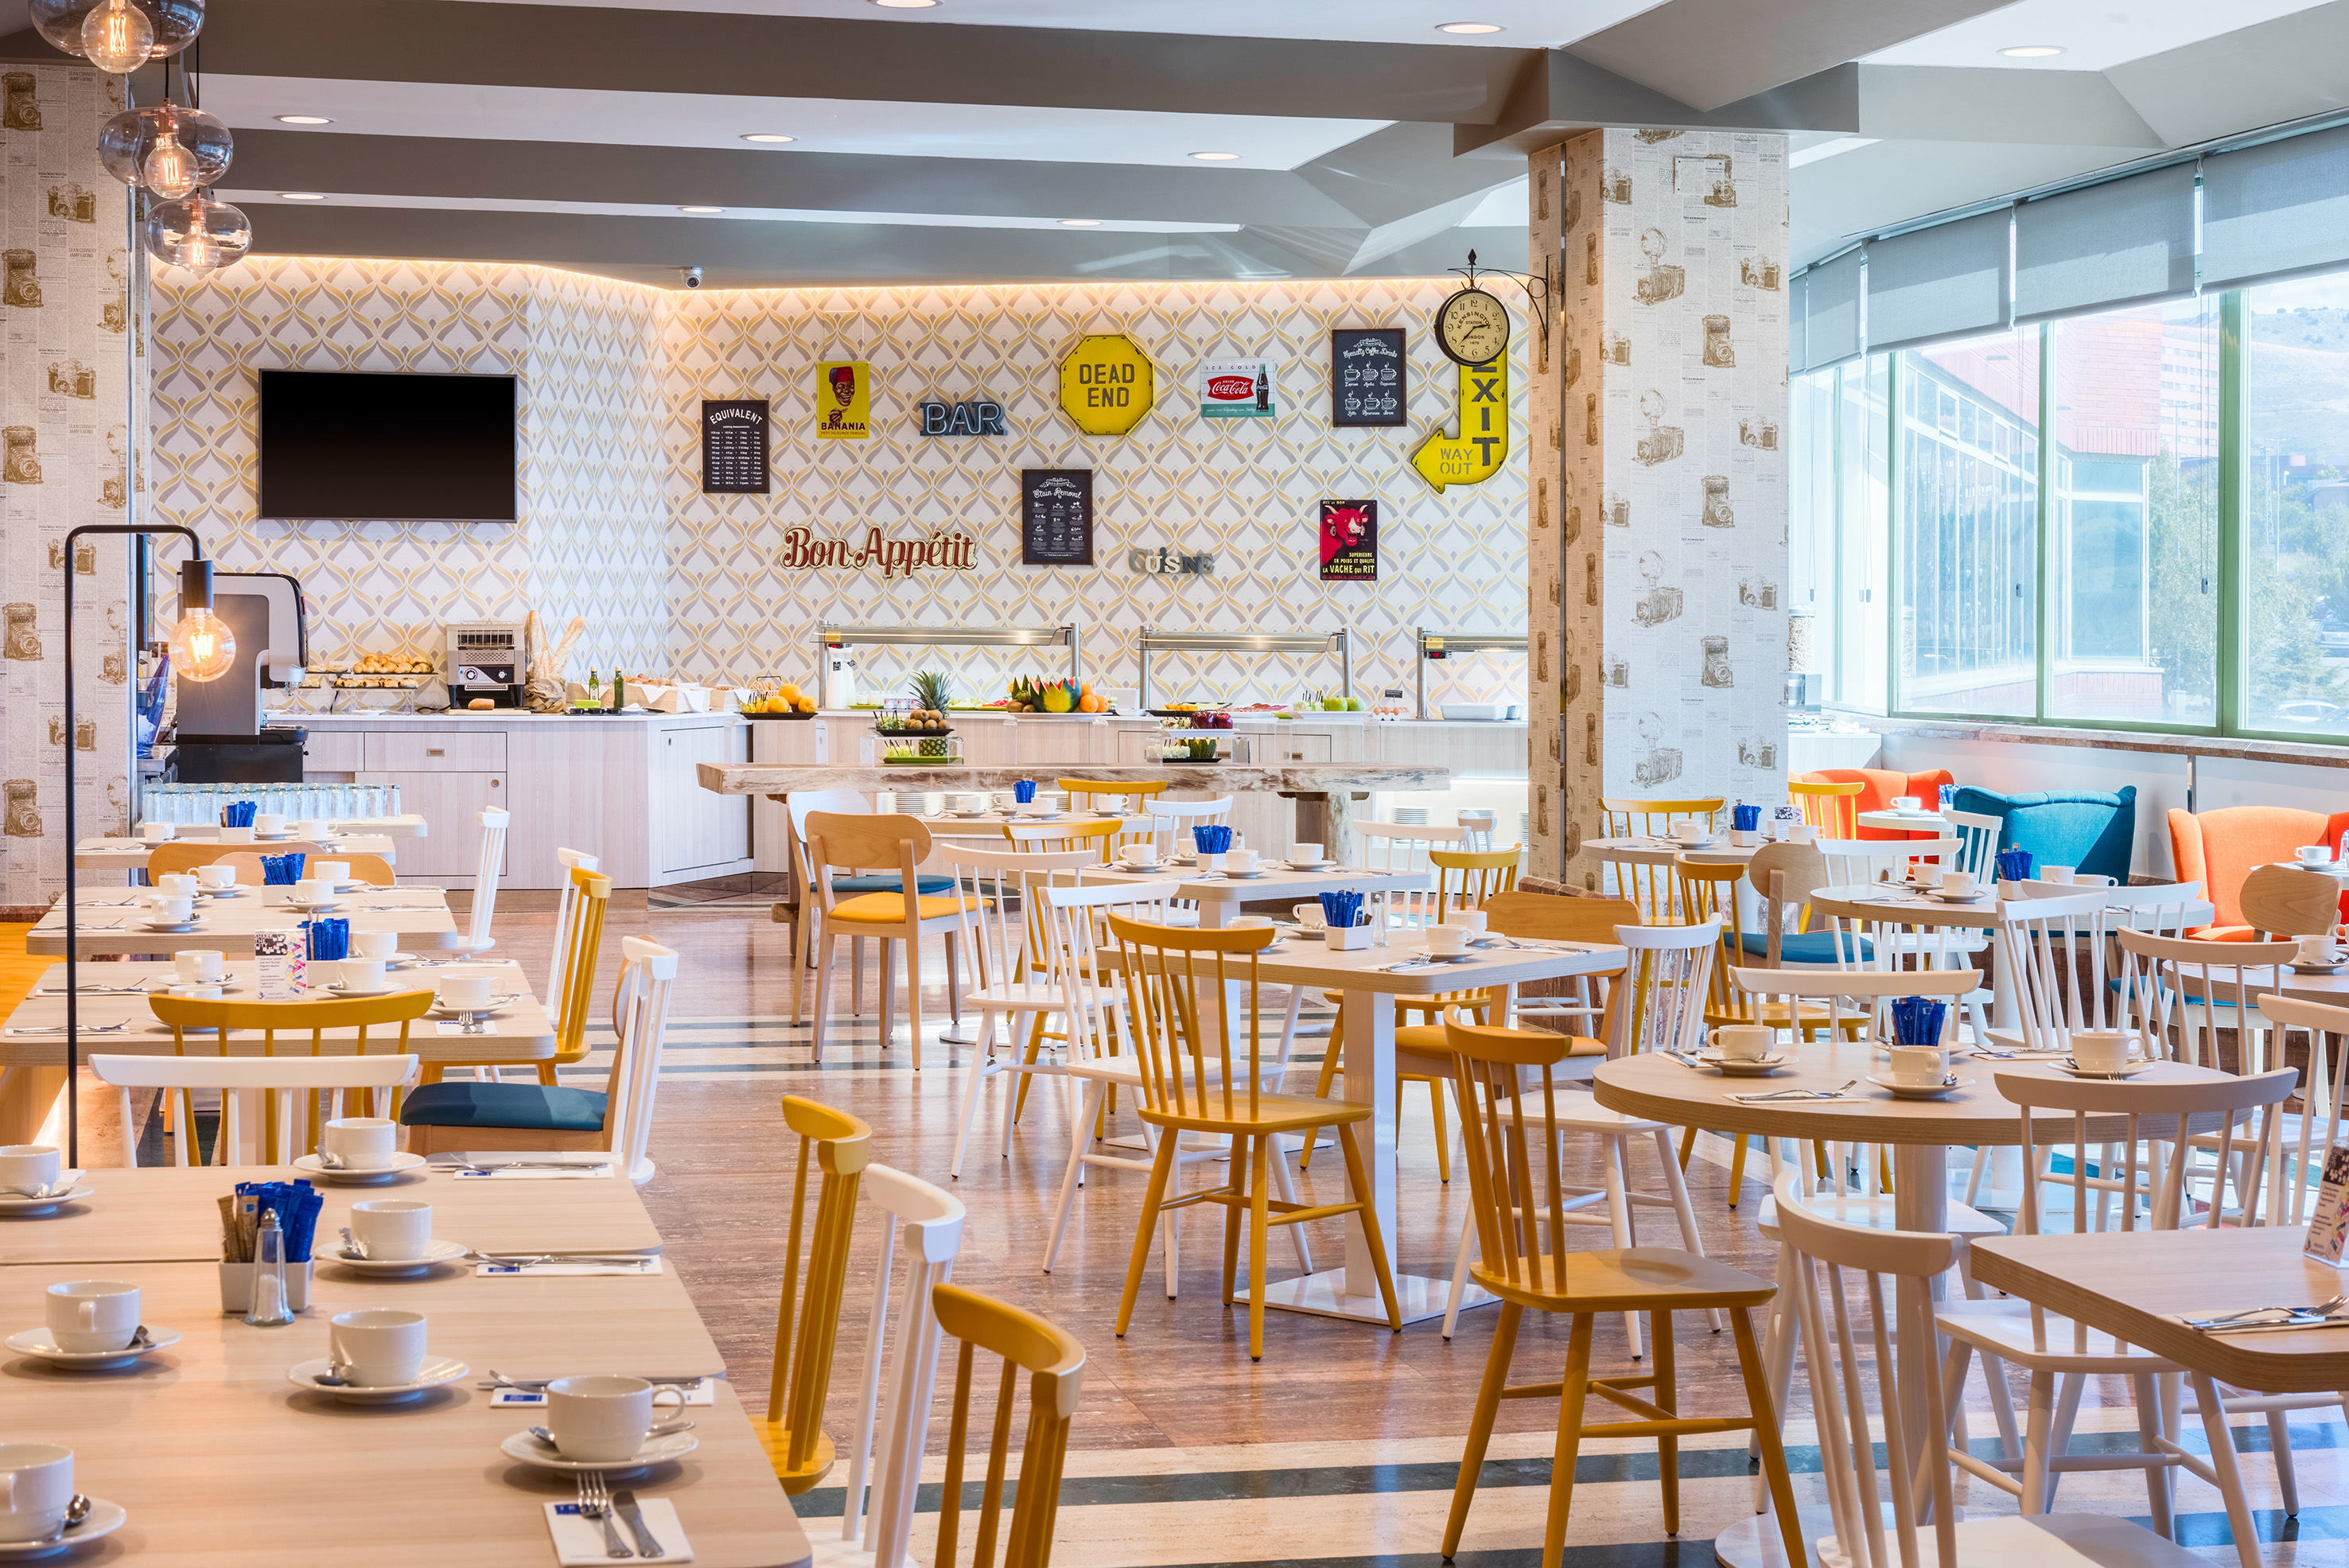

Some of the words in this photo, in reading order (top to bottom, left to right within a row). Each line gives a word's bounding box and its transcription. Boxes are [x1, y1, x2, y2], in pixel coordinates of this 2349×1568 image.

[1457, 312, 1491, 329] KENSINGTON
[1343, 348, 1365, 359] Specialty
[1365, 348, 1379, 356] Coffee
[1379, 348, 1398, 357] Drinks
[1484, 346, 1490, 355] 5
[1079, 364, 1134, 384] DEAD
[1088, 387, 1130, 407] END
[710, 408, 763, 424] EQUIVALENT
[920, 402, 1007, 436] BAR
[1441, 448, 1473, 461] WAY
[1440, 462, 1472, 475] OUT
[1033, 488, 1052, 498] Stain
[1053, 487, 1082, 499] Removal
[784, 527, 850, 567] Bon
[854, 527, 974, 576] Appétit
